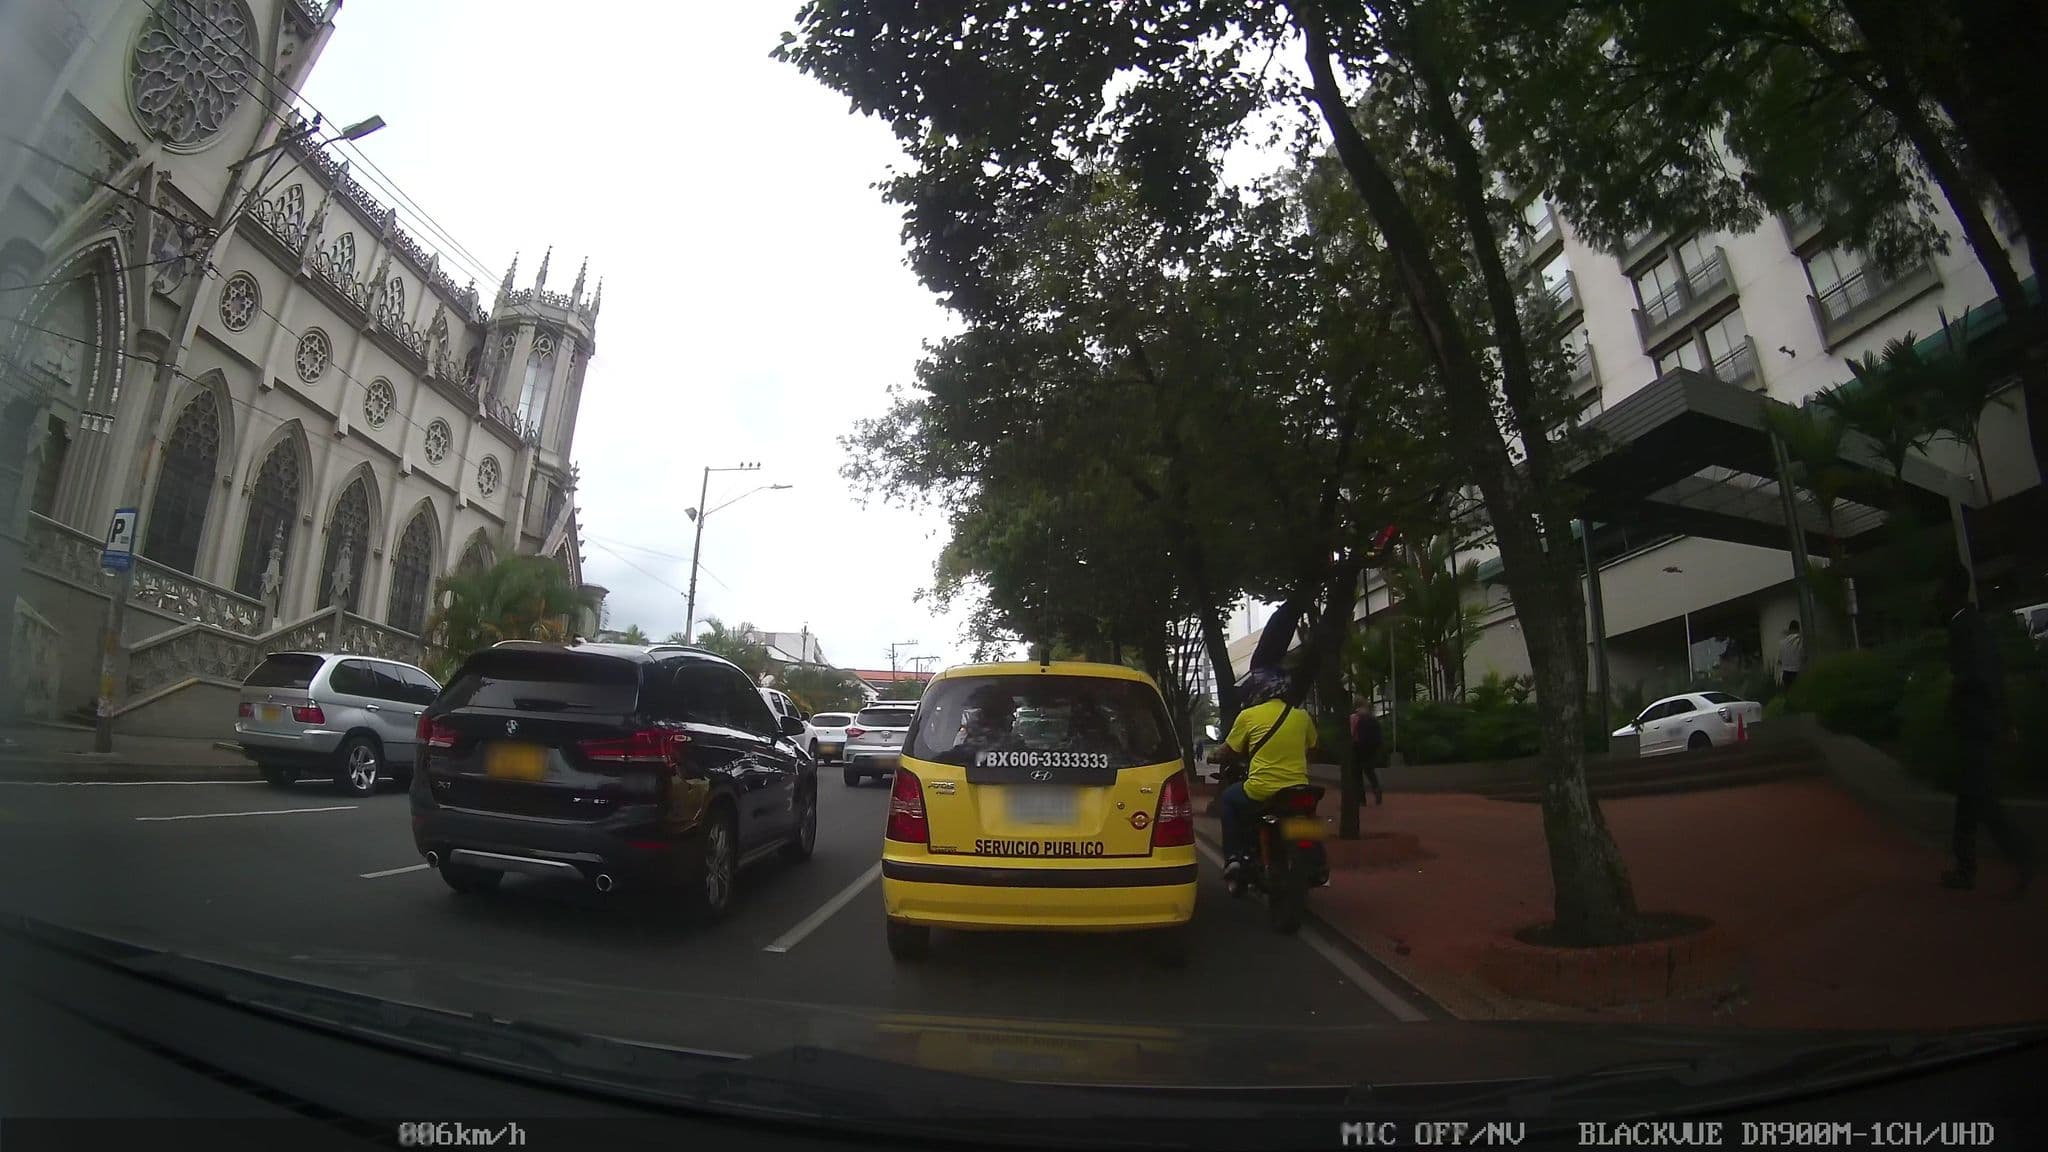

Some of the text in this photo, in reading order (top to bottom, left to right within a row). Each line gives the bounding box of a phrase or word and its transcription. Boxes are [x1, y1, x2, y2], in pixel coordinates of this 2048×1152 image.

[110, 518, 126, 543] P
[975, 839, 1039, 855] SERVICIO
[1044, 841, 1104, 856] PUBLICO
